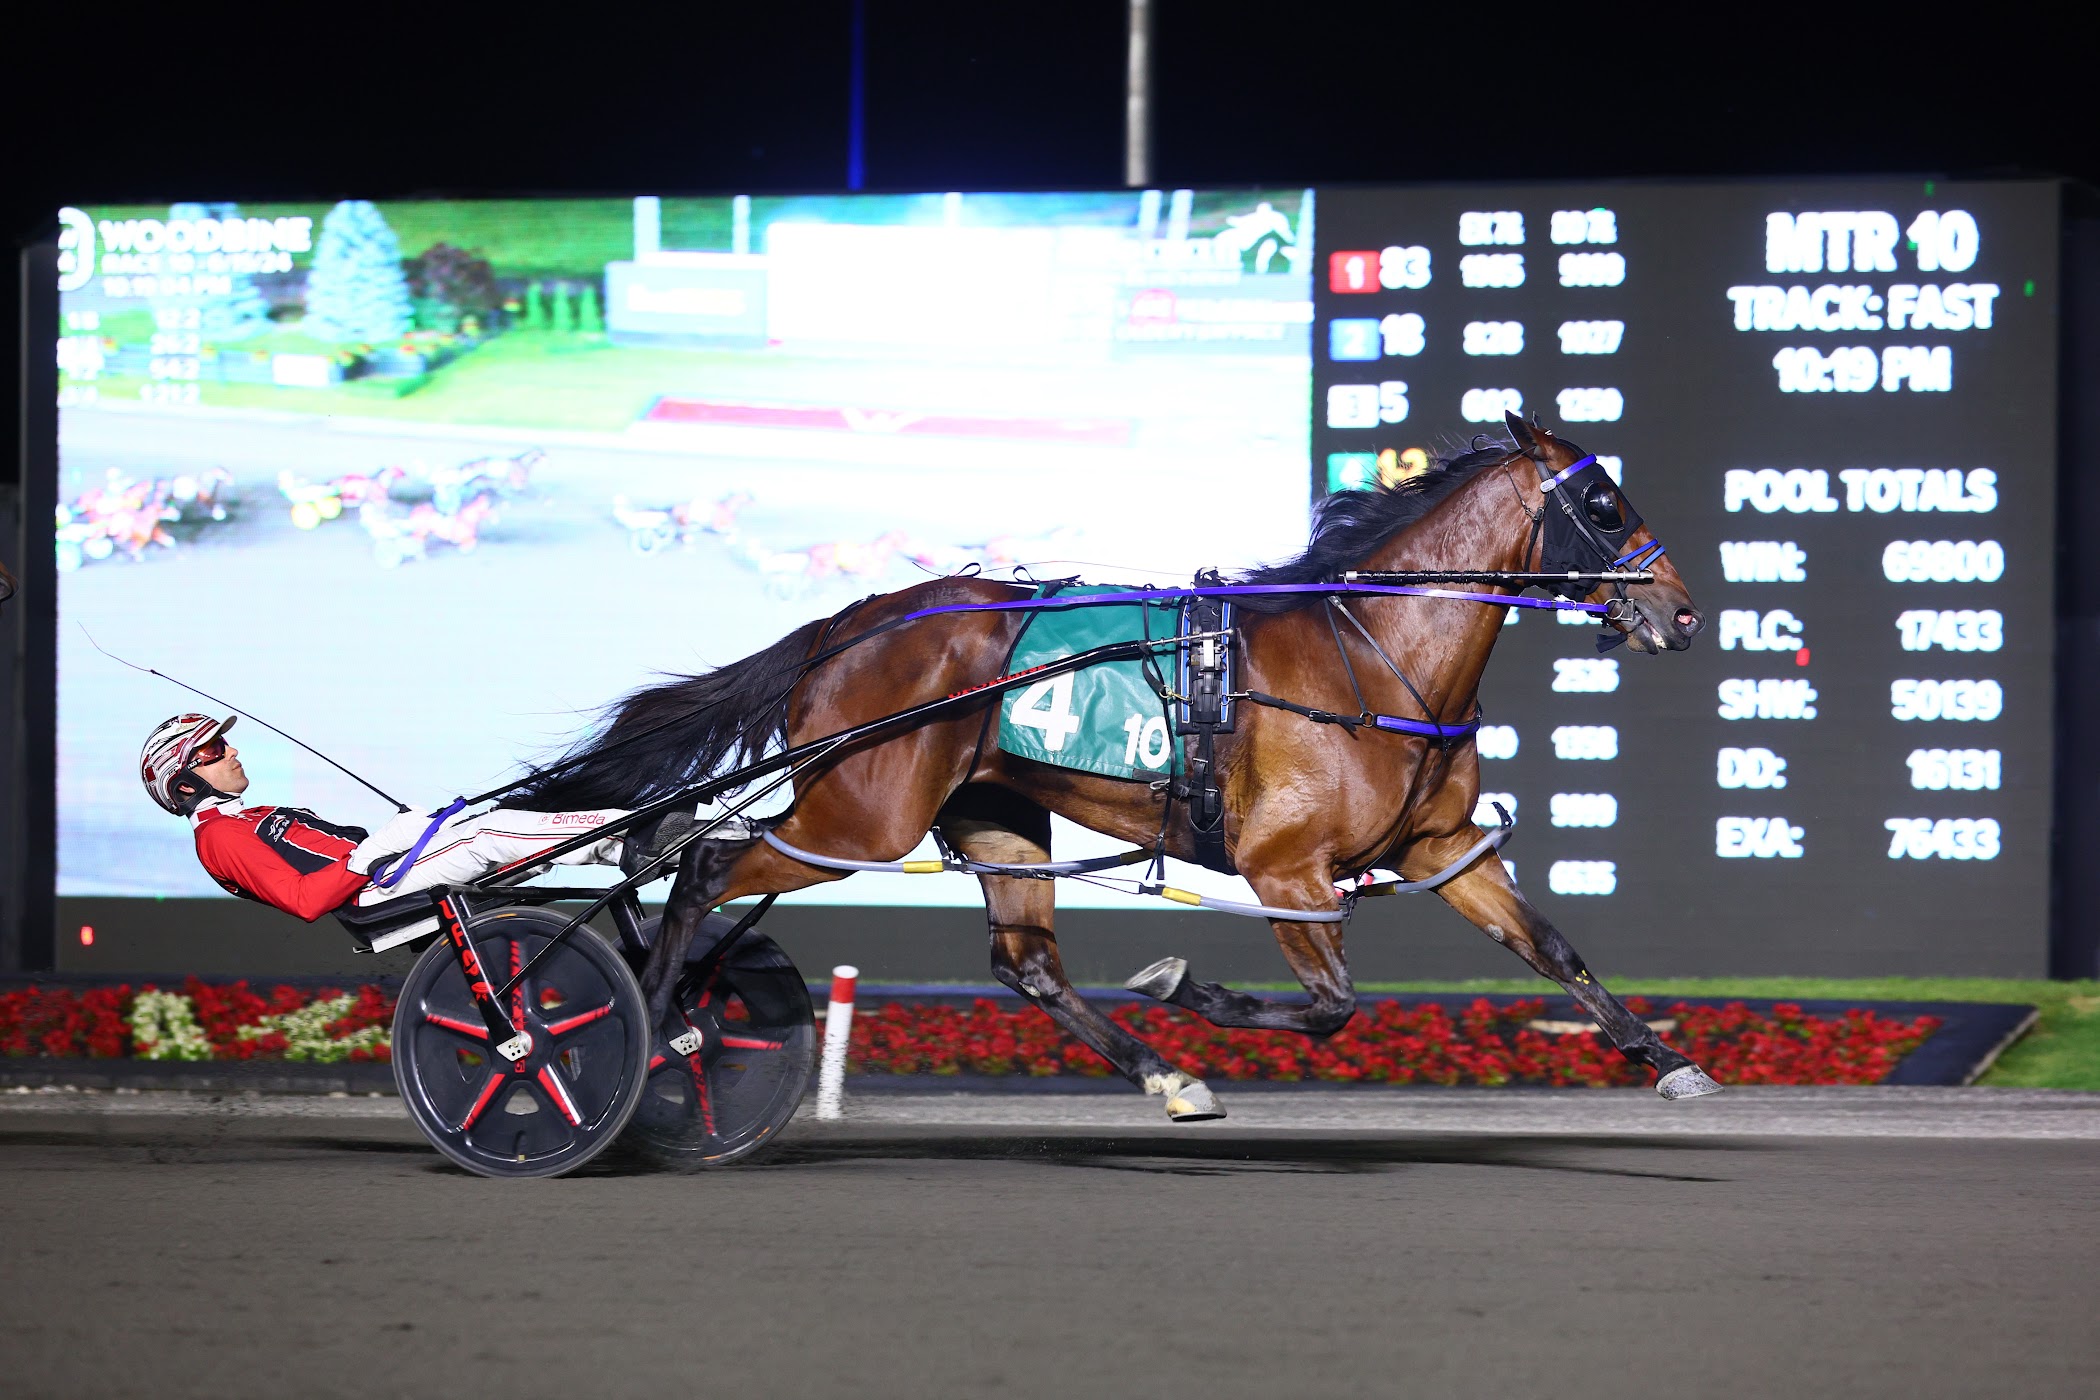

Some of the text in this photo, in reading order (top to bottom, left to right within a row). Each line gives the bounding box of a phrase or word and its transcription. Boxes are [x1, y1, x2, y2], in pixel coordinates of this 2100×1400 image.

[98, 217, 312, 253] WOODBINE
[1766, 210, 1979, 273] MTR 10
[1344, 254, 1366, 291] 1
[1727, 284, 2000, 331] TRACK: FAST
[1773, 346, 1952, 393] 10:19 PM
[1379, 381, 1409, 423] 5
[1724, 468, 1998, 513] POOL TOTALS
[1719, 541, 1807, 582] WIN:
[1718, 609, 2003, 652] PLC: 17433
[1010, 654, 1080, 751] 4
[1717, 678, 2003, 721] SHW: 50139
[1124, 713, 1171, 769] 10
[1717, 747, 2002, 790] DD: 16131
[551, 812, 606, 825] Bimeda
[1716, 817, 2001, 860] EXA: 76433
